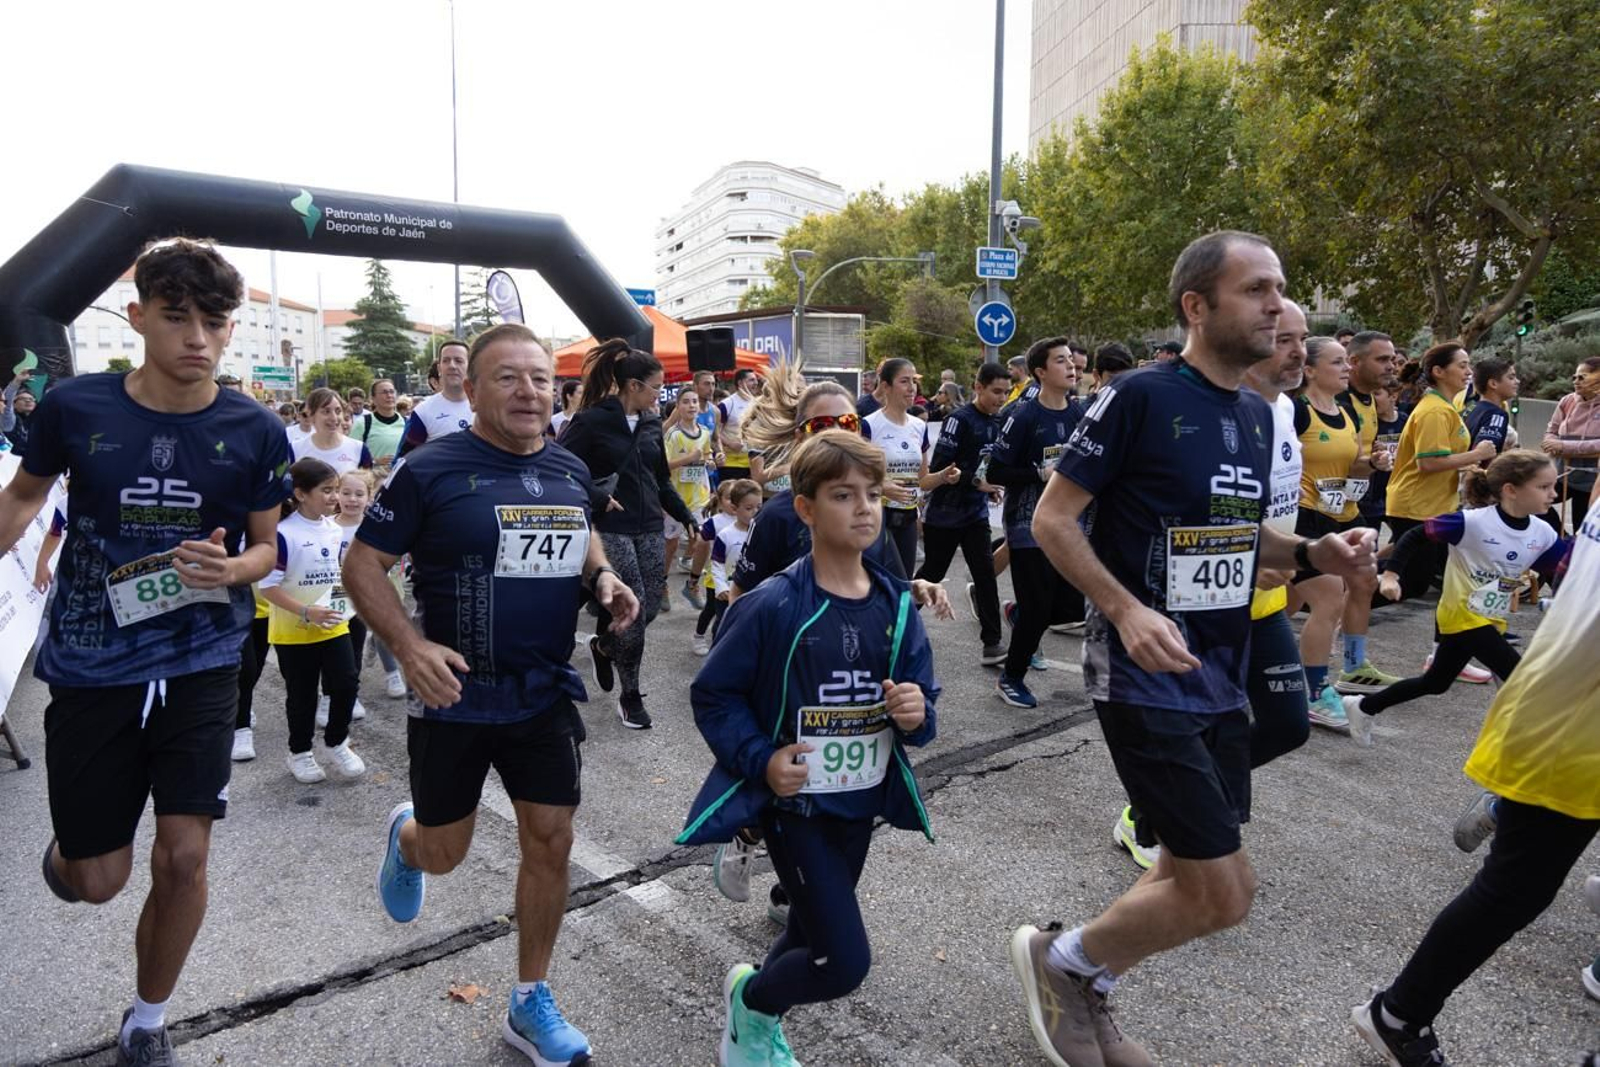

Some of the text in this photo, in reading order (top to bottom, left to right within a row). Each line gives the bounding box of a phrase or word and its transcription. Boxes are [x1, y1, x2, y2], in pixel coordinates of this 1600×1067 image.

[325, 207, 453, 230] Patronato Municipal de
[326, 220, 426, 239] Deportes de Jaén
[989, 251, 1015, 261] Plaza del
[120, 477, 202, 508] 25
[1210, 463, 1262, 499] 25
[119, 506, 201, 516] CARRERA
[119, 513, 203, 526] POPULAR
[501, 510, 522, 522] XXV
[519, 533, 573, 560] 747
[1173, 531, 1199, 546] XXV
[1150, 536, 1165, 591] ATALINA
[1192, 557, 1244, 590] 408
[136, 572, 183, 602] 88
[461, 572, 472, 634] CATALINA
[818, 670, 883, 703] 25
[804, 711, 830, 727] XXV
[831, 711, 869, 719] CARRERA
[842, 719, 864, 727] gran
[823, 738, 879, 773] 991
